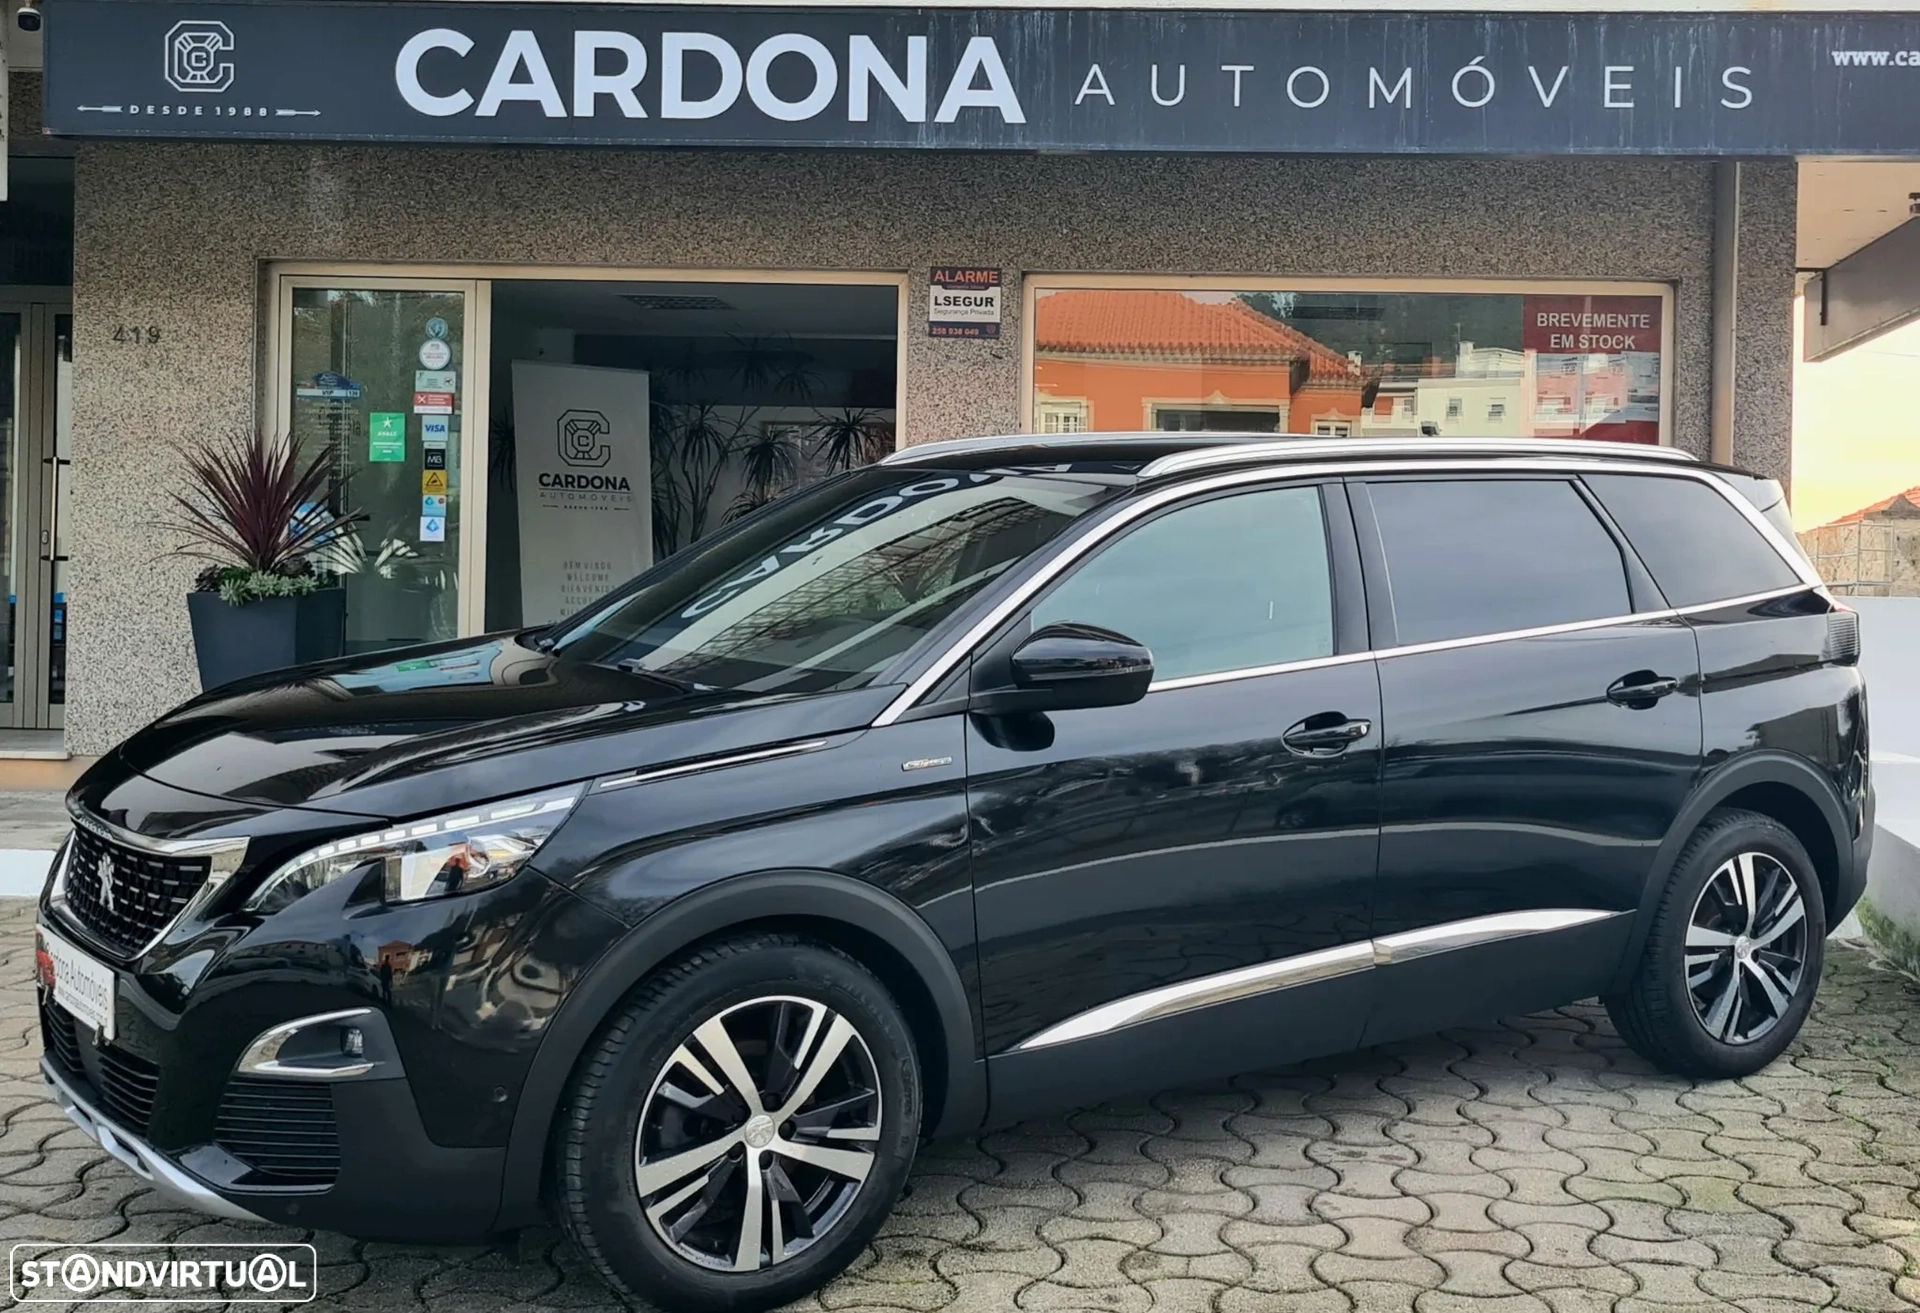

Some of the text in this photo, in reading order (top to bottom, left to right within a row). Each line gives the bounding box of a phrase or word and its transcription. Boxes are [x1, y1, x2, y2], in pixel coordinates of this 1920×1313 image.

[396, 29, 1755, 125] CARDONA AUTOMÓVEIS
[129, 104, 268, 118] DESDE 1988
[934, 270, 998, 284] ALARME
[934, 295, 994, 307] LSEGUR
[933, 308, 969, 316] Segurança
[1536, 312, 1652, 329] BREVEMENTE
[112, 325, 161, 345] 419
[1549, 334, 1636, 349] EM STOCK
[424, 424, 446, 433] VISA
[427, 454, 443, 465] MB
[538, 472, 631, 491] CARDONA
